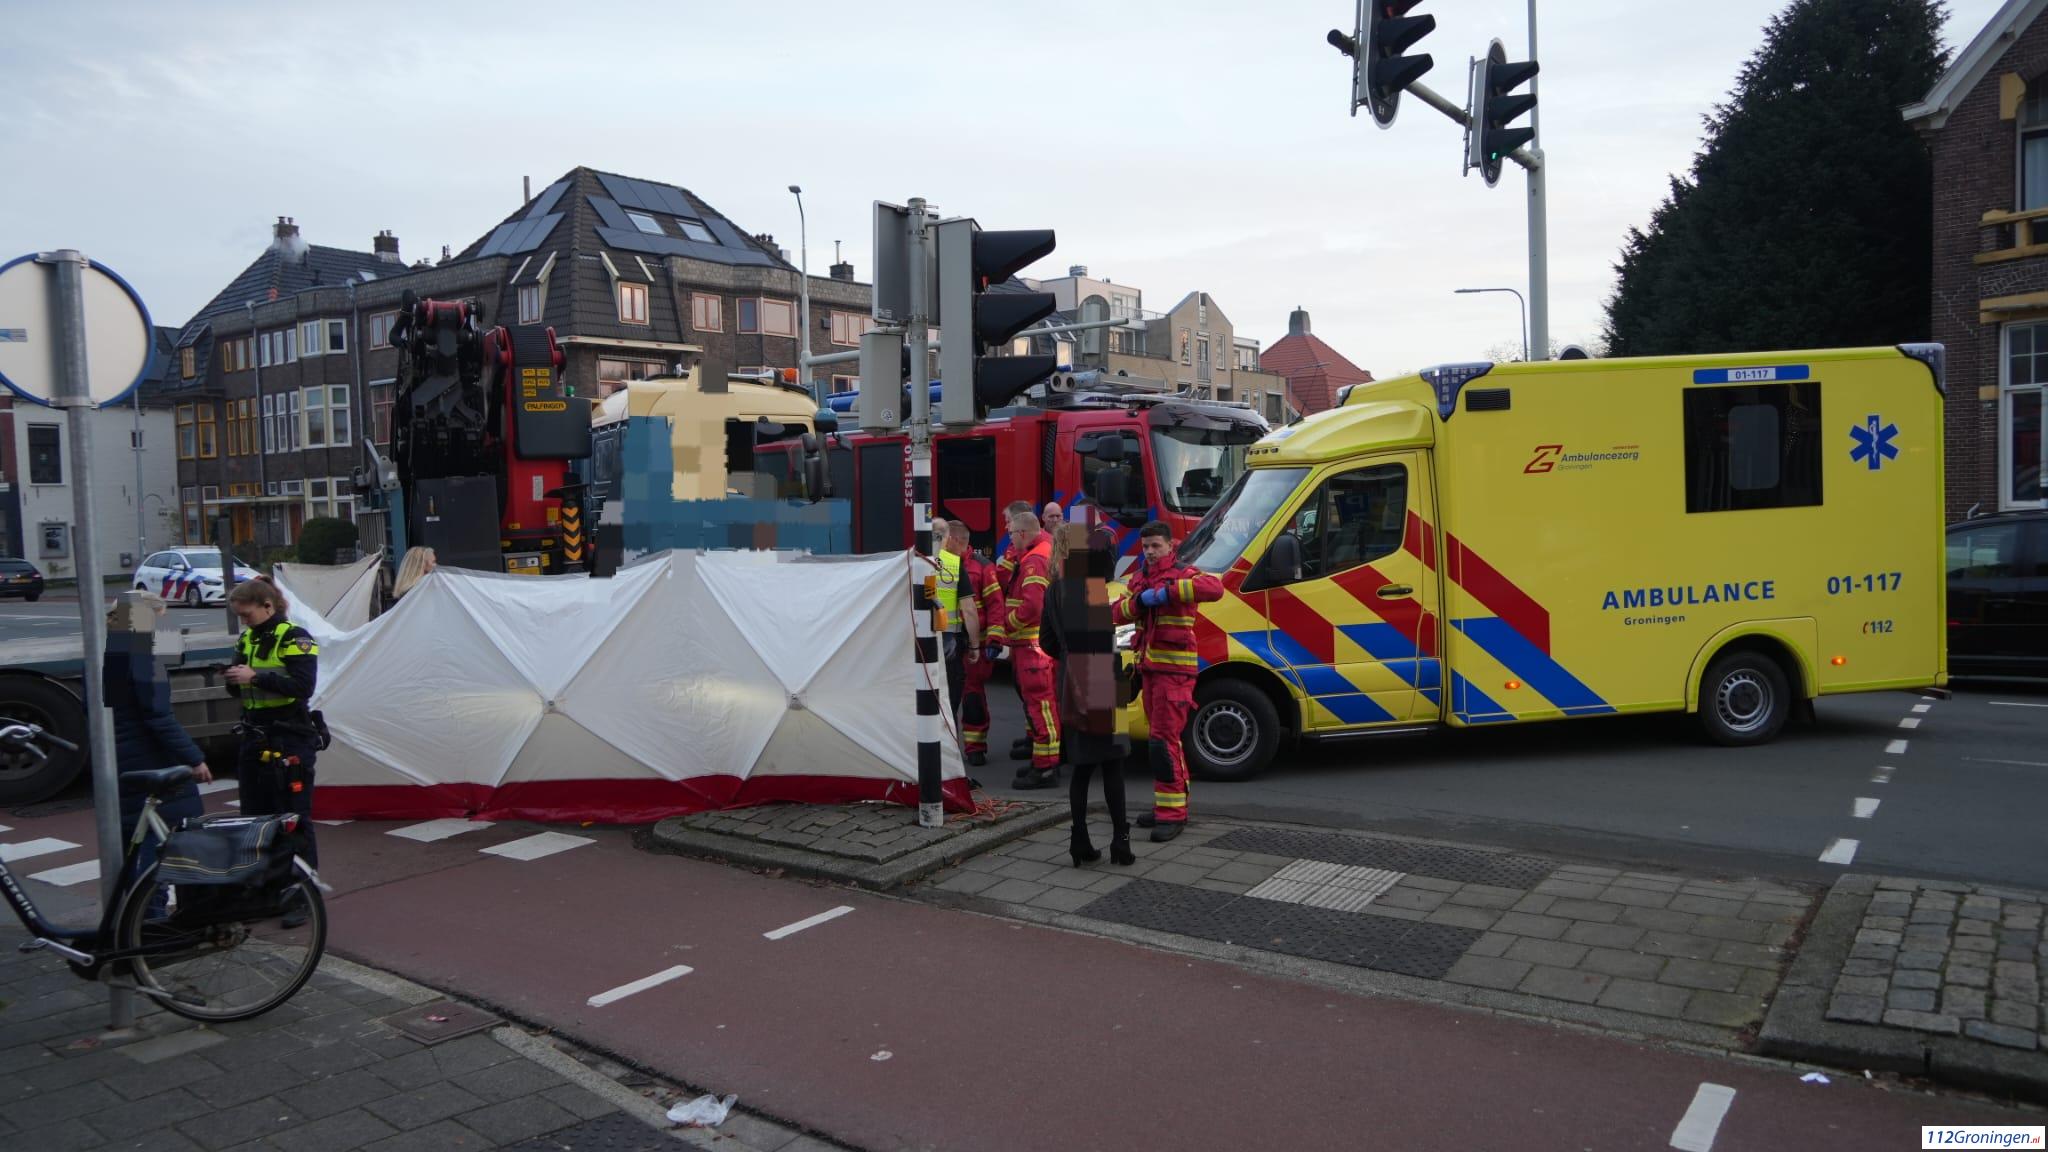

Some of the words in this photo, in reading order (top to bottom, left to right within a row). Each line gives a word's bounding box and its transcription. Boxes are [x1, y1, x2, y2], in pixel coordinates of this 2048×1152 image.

[1735, 370, 1768, 380] 01-117
[1561, 450, 1639, 463] Ambulancezorg
[904, 445, 913, 507] 01-1832
[1827, 572, 1902, 595] 01-117
[1602, 580, 1776, 610] AMBULANCE
[1624, 614, 1686, 626] Groningen
[1870, 619, 1893, 634] 112
